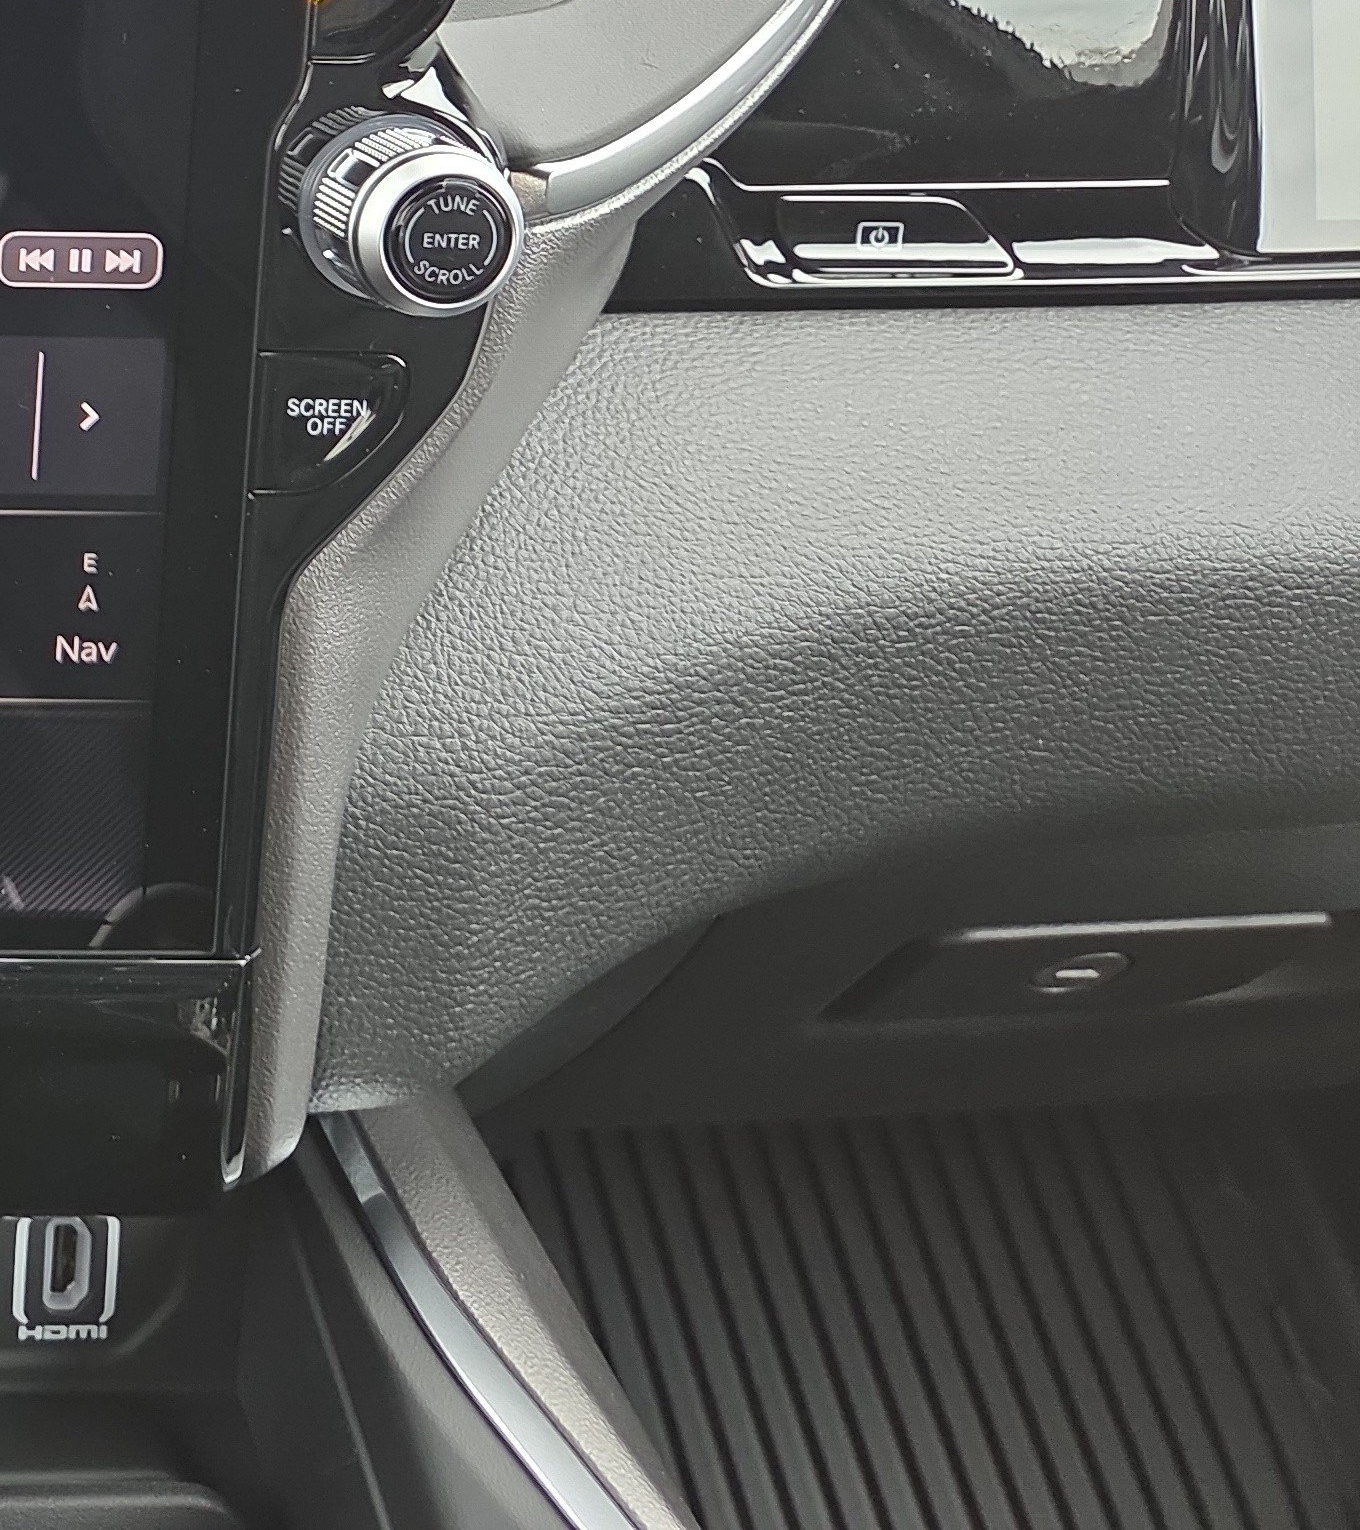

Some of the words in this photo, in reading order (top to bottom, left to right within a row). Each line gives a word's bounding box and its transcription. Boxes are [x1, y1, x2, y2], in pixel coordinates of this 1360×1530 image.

[427, 194, 479, 216] TUNE
[422, 233, 480, 250] ENTER
[413, 259, 484, 285] SCROLL
[287, 398, 368, 418] SCREEN
[306, 418, 348, 436] OFF
[55, 635, 118, 664] Nav
[18, 1324, 108, 1341] HDMI
